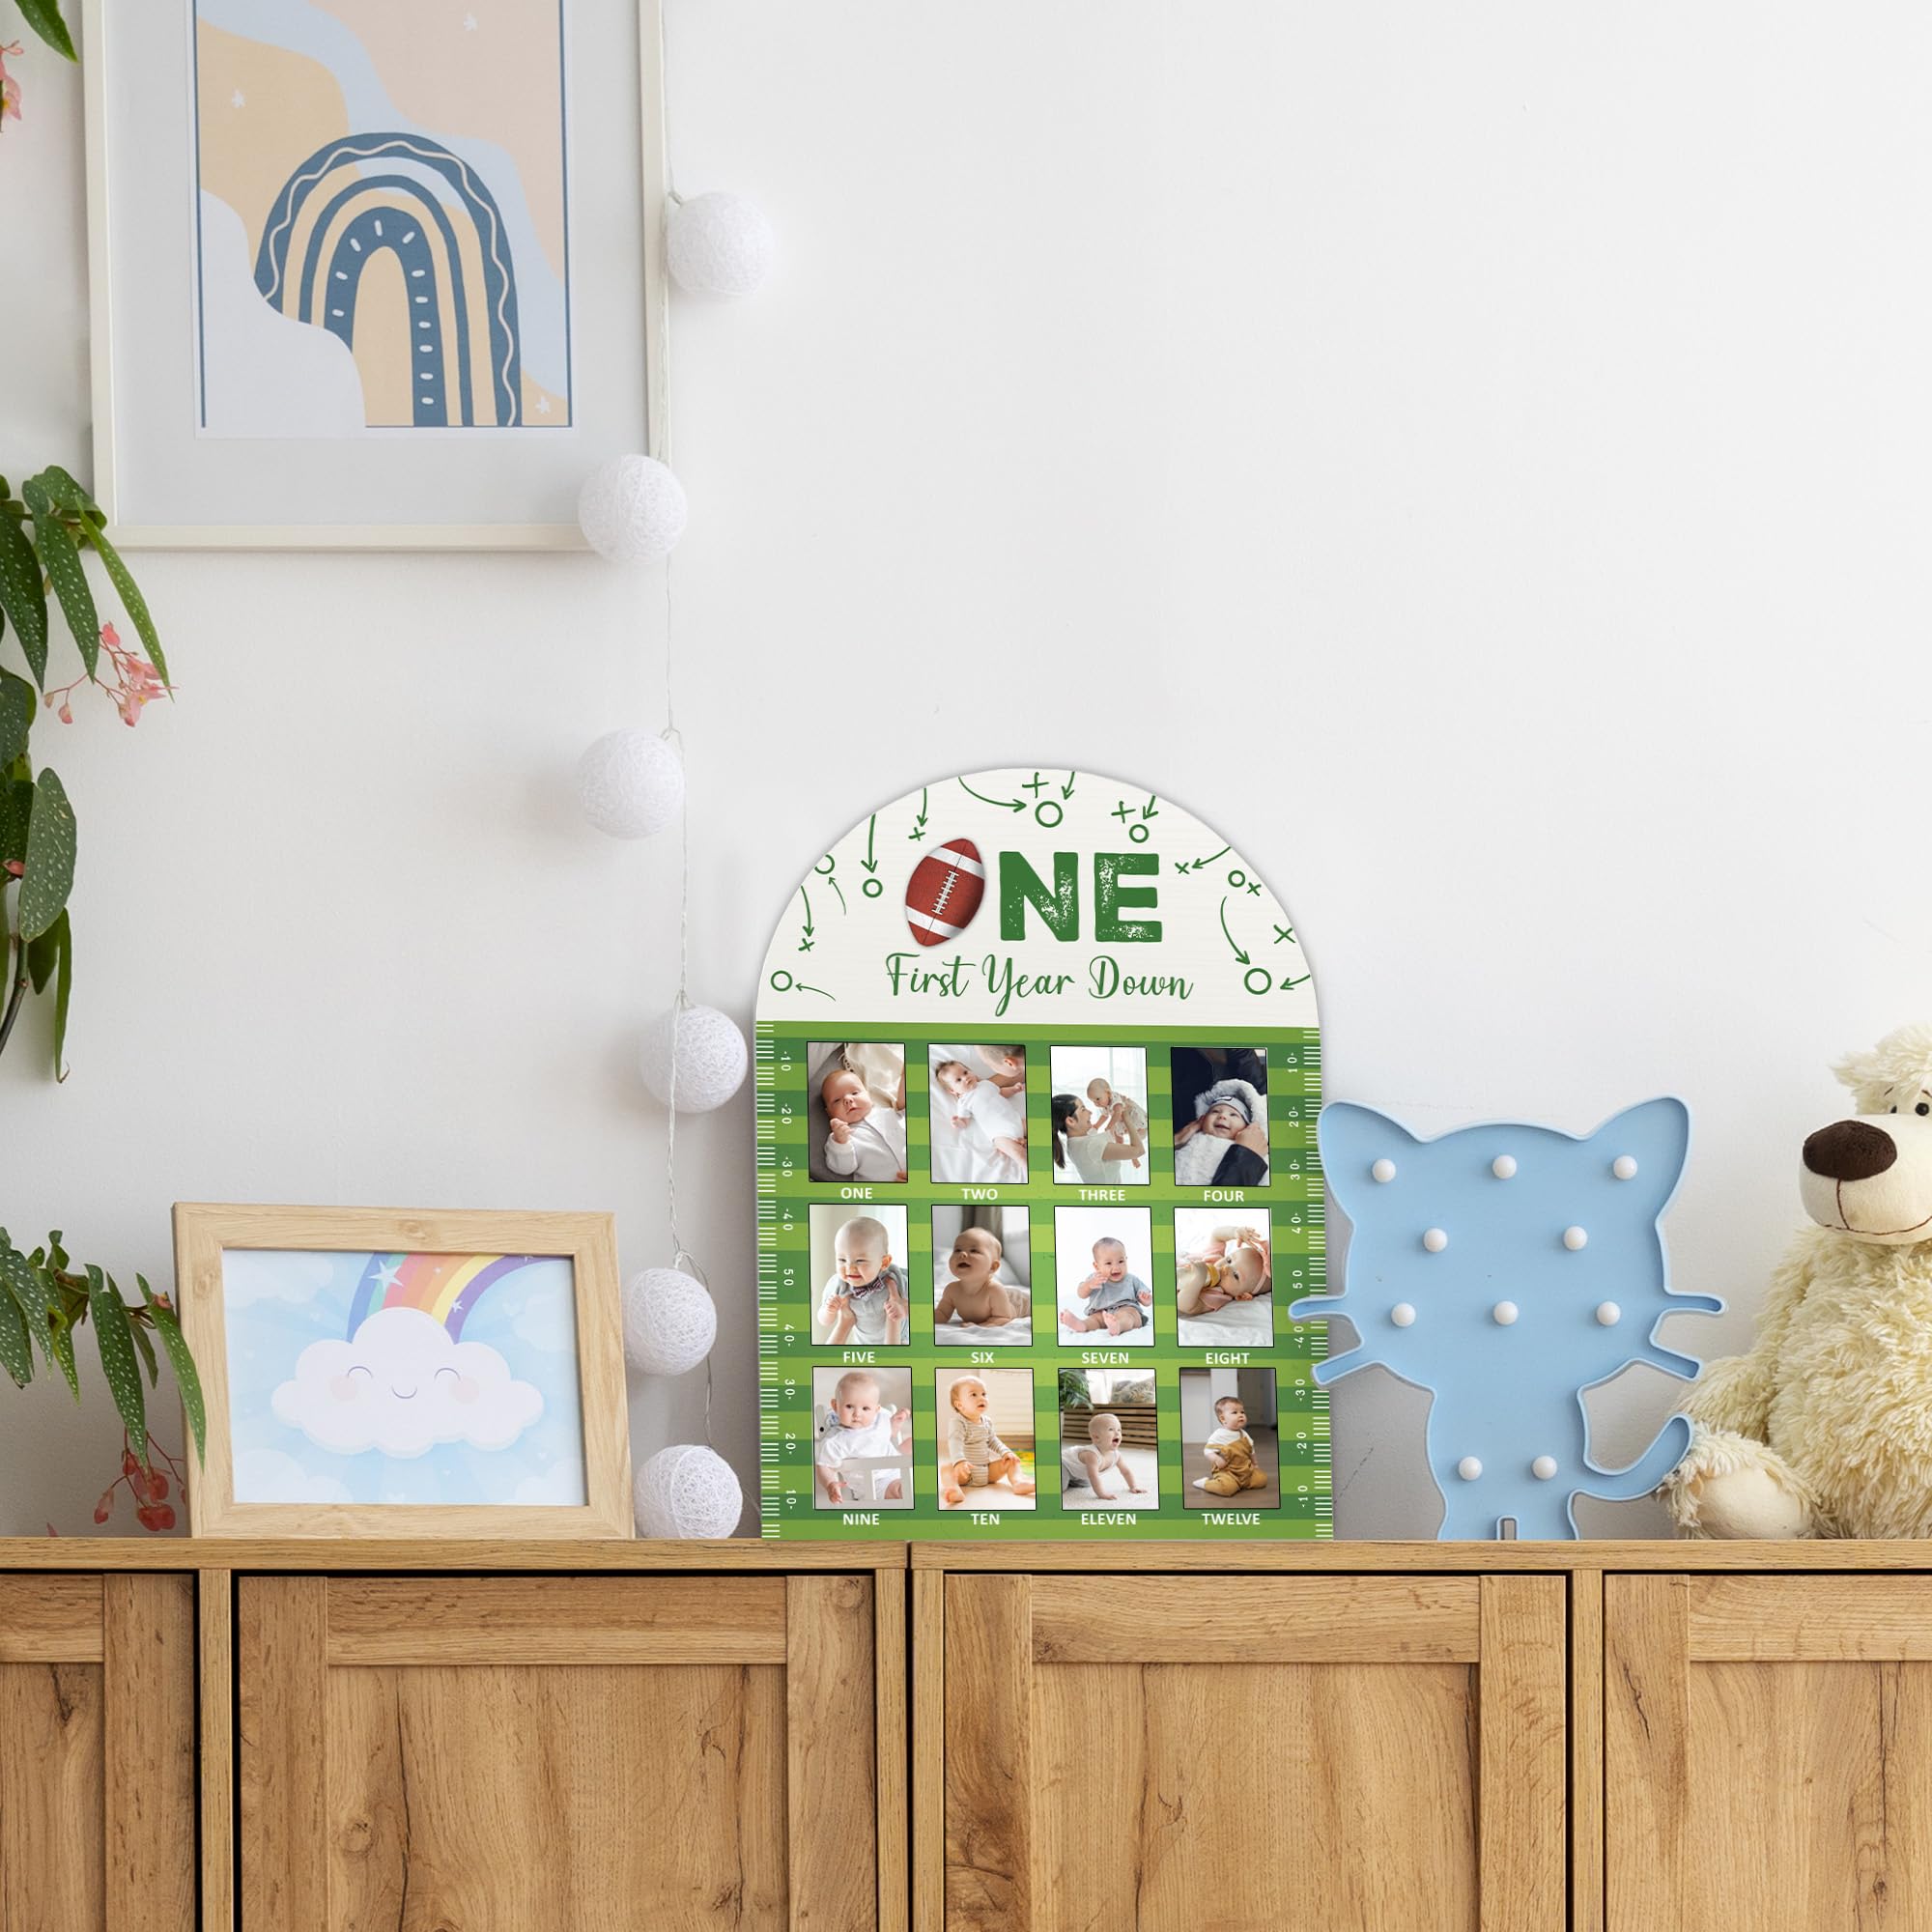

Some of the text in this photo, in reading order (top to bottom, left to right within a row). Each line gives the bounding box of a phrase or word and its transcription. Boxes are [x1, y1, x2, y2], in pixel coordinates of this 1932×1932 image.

[885, 952, 1194, 1017] First Year Down
[840, 1187, 873, 1200] ONE
[961, 1187, 998, 1201] TWO
[1078, 1189, 1125, 1202] THREE
[1204, 1189, 1244, 1203] FOUR
[842, 1350, 875, 1364] FIVE
[971, 1351, 994, 1364] SIX
[1081, 1351, 1131, 1365] SEVEN
[1206, 1352, 1251, 1365] EIGHT
[842, 1513, 880, 1525] NINE
[970, 1513, 1000, 1525] TEN
[1081, 1513, 1137, 1525] ELEVEN
[1201, 1513, 1261, 1525] TWELVE
